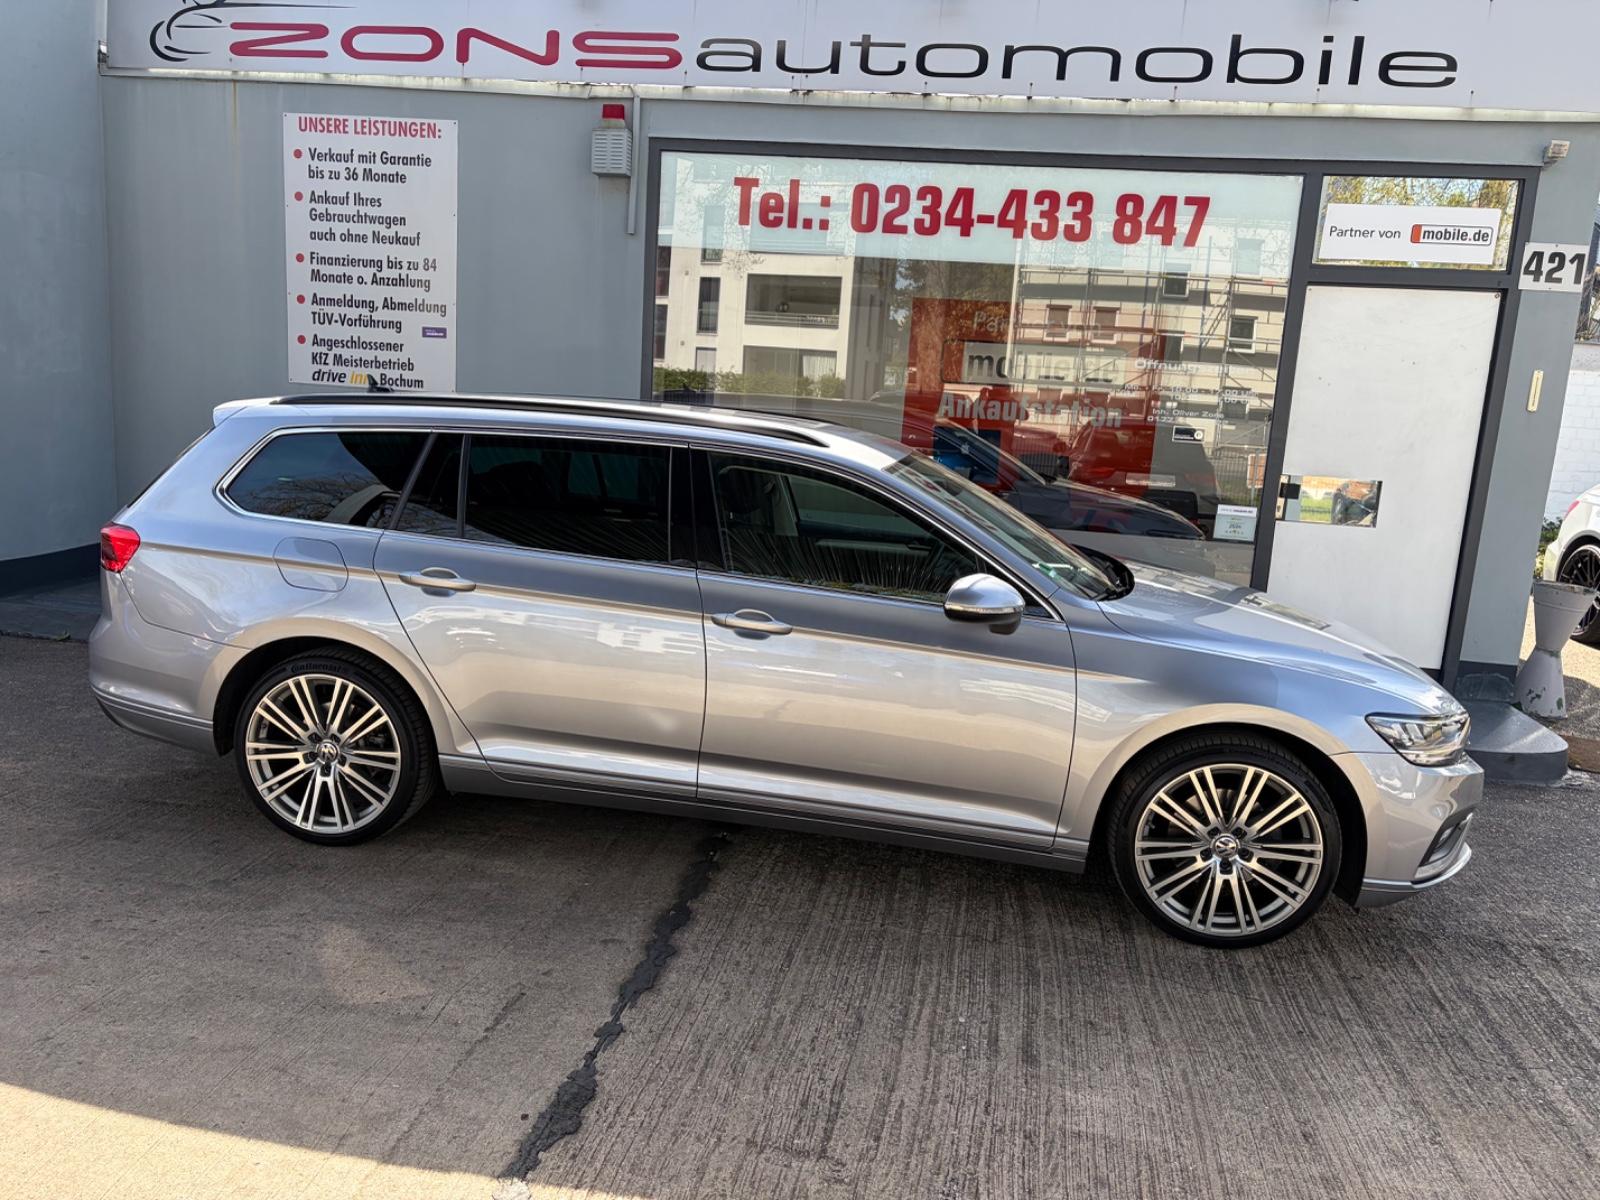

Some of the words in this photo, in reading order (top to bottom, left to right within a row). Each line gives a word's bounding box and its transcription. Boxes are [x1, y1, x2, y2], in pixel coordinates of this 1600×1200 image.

[298, 116, 349, 134] UNSERE
[308, 147, 354, 164] Verkauf
[358, 152, 376, 165] mit
[380, 151, 432, 167] Garantie
[308, 165, 324, 180] bis
[328, 169, 340, 181] zu
[344, 167, 358, 181] 36
[362, 169, 407, 184] Monate
[309, 190, 350, 206] Ankauf
[353, 192, 382, 208] Ihres
[309, 208, 406, 229] Gebrauchtwagen
[734, 176, 831, 231] Tel.:
[850, 182, 1094, 243] 0234-433
[1112, 193, 1211, 247] 847
[309, 227, 336, 242] auch
[339, 230, 368, 243] ohne
[372, 230, 420, 246] Neukauf
[1329, 226, 1375, 239] Partner
[1378, 229, 1401, 239] von
[1422, 228, 1489, 242] mobile.de
[310, 252, 383, 273] Finanzierung
[387, 256, 403, 270] bis
[406, 260, 419, 271] zu
[422, 257, 437, 272] 84
[1522, 251, 1586, 285] 421
[310, 269, 353, 285] Monate
[357, 275, 367, 285] o.
[371, 272, 431, 292] Anzahlung
[311, 293, 379, 313] Anmeldung,
[382, 296, 447, 317] Abmeldung
[311, 308, 402, 334] TÜV-Vorführung
[312, 334, 404, 353] Angeschlossener
[311, 352, 329, 366] KfZ
[332, 354, 415, 371] Meisterbetrieb
[312, 369, 346, 383] drive
[380, 373, 424, 389] Bochum
[938, 392, 1122, 428] Ankaufstation
[1172, 409, 1200, 418] Oliver
